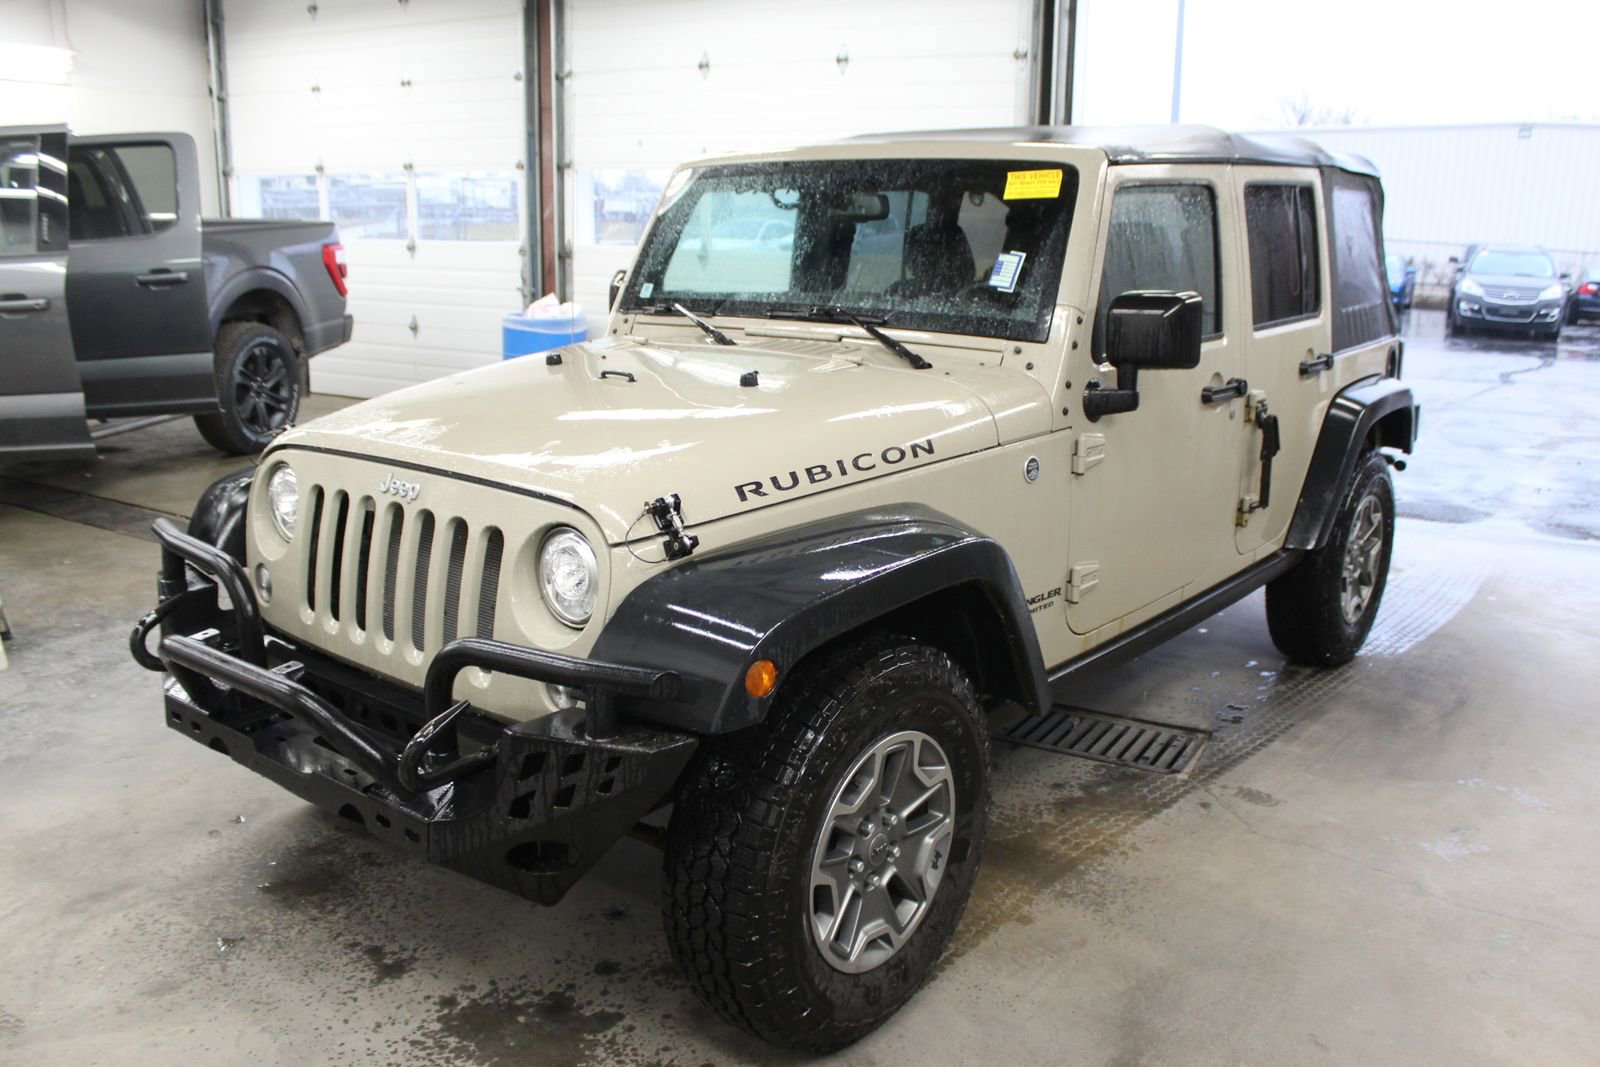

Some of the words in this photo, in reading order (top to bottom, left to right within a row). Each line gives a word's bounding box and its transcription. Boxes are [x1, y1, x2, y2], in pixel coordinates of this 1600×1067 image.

[1010, 173, 1027, 181] THIS
[1030, 171, 1060, 180] VEHICLE
[734, 439, 935, 502] RUBICON
[379, 472, 420, 504] Jeep
[1026, 586, 1062, 605] NGLER
